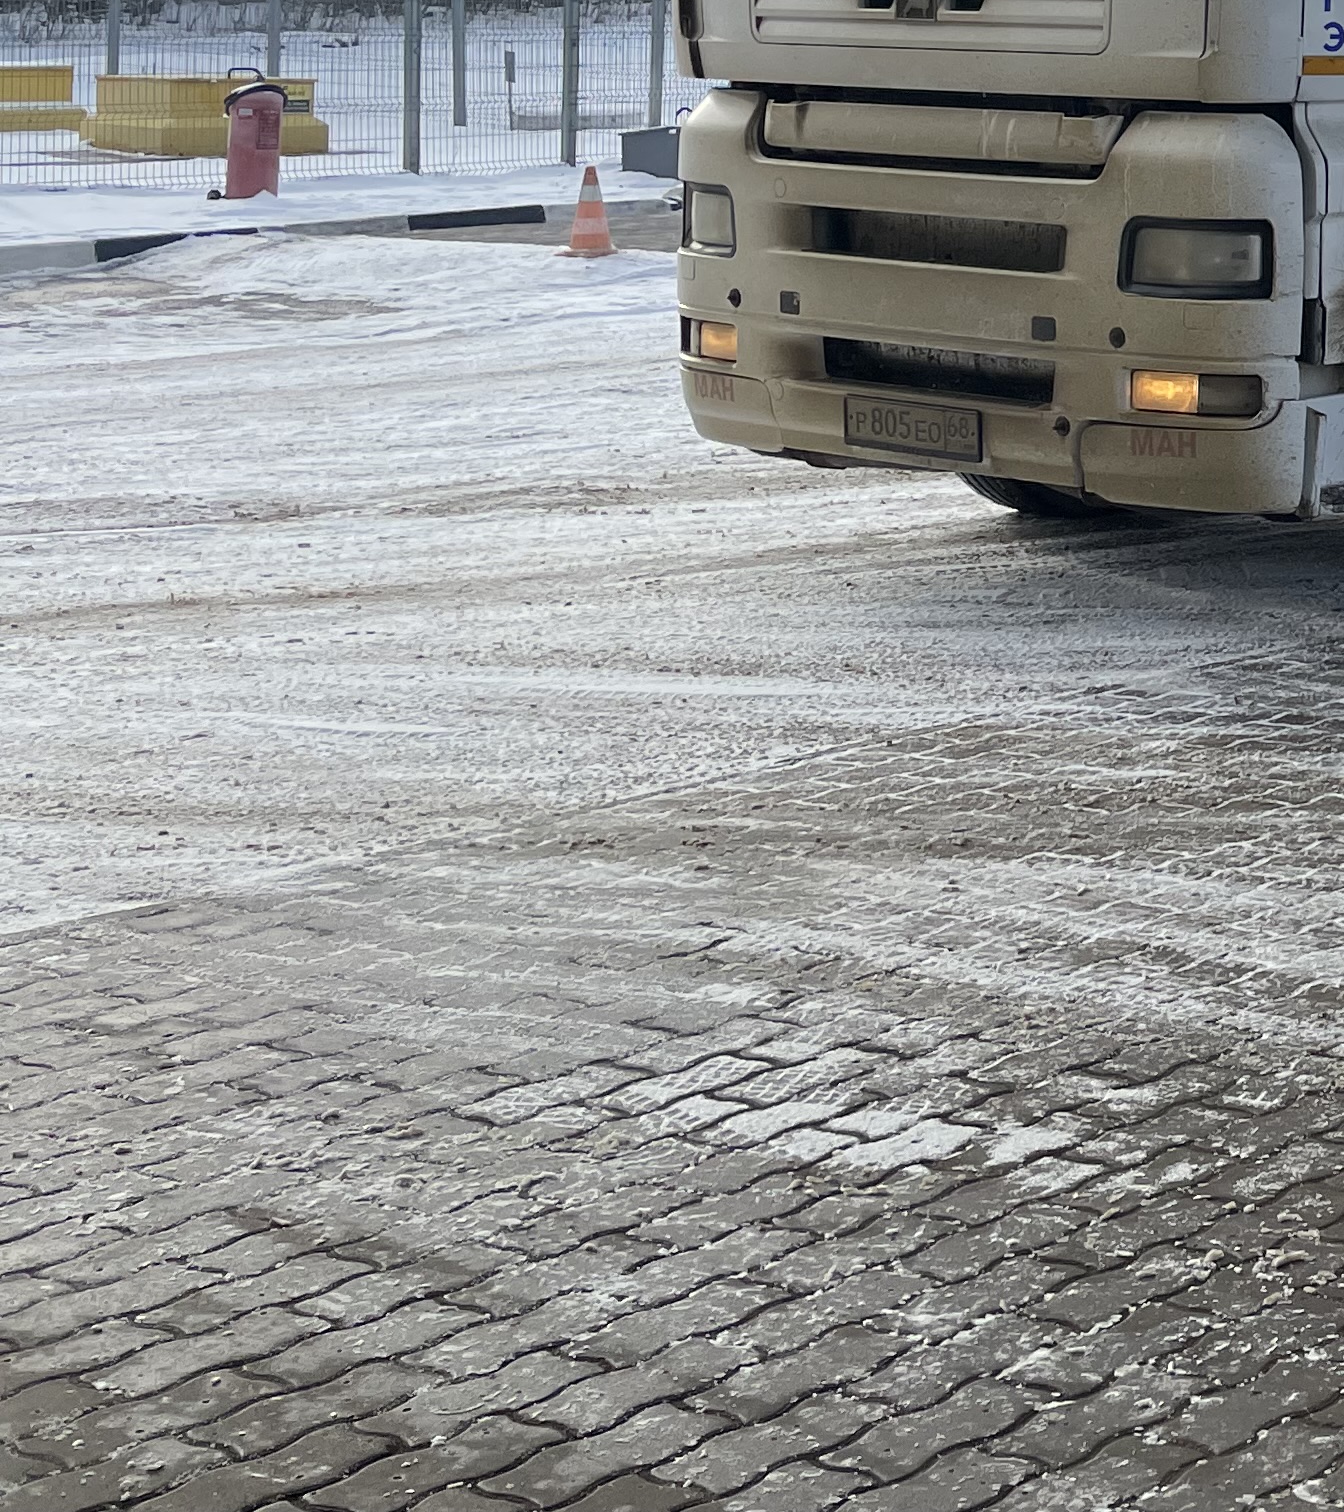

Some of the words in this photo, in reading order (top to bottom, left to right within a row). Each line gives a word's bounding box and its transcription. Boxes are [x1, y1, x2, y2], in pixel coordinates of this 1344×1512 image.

[693, 373, 735, 402] МАН
[947, 416, 969, 439] 68
[1130, 429, 1197, 458] МАН
